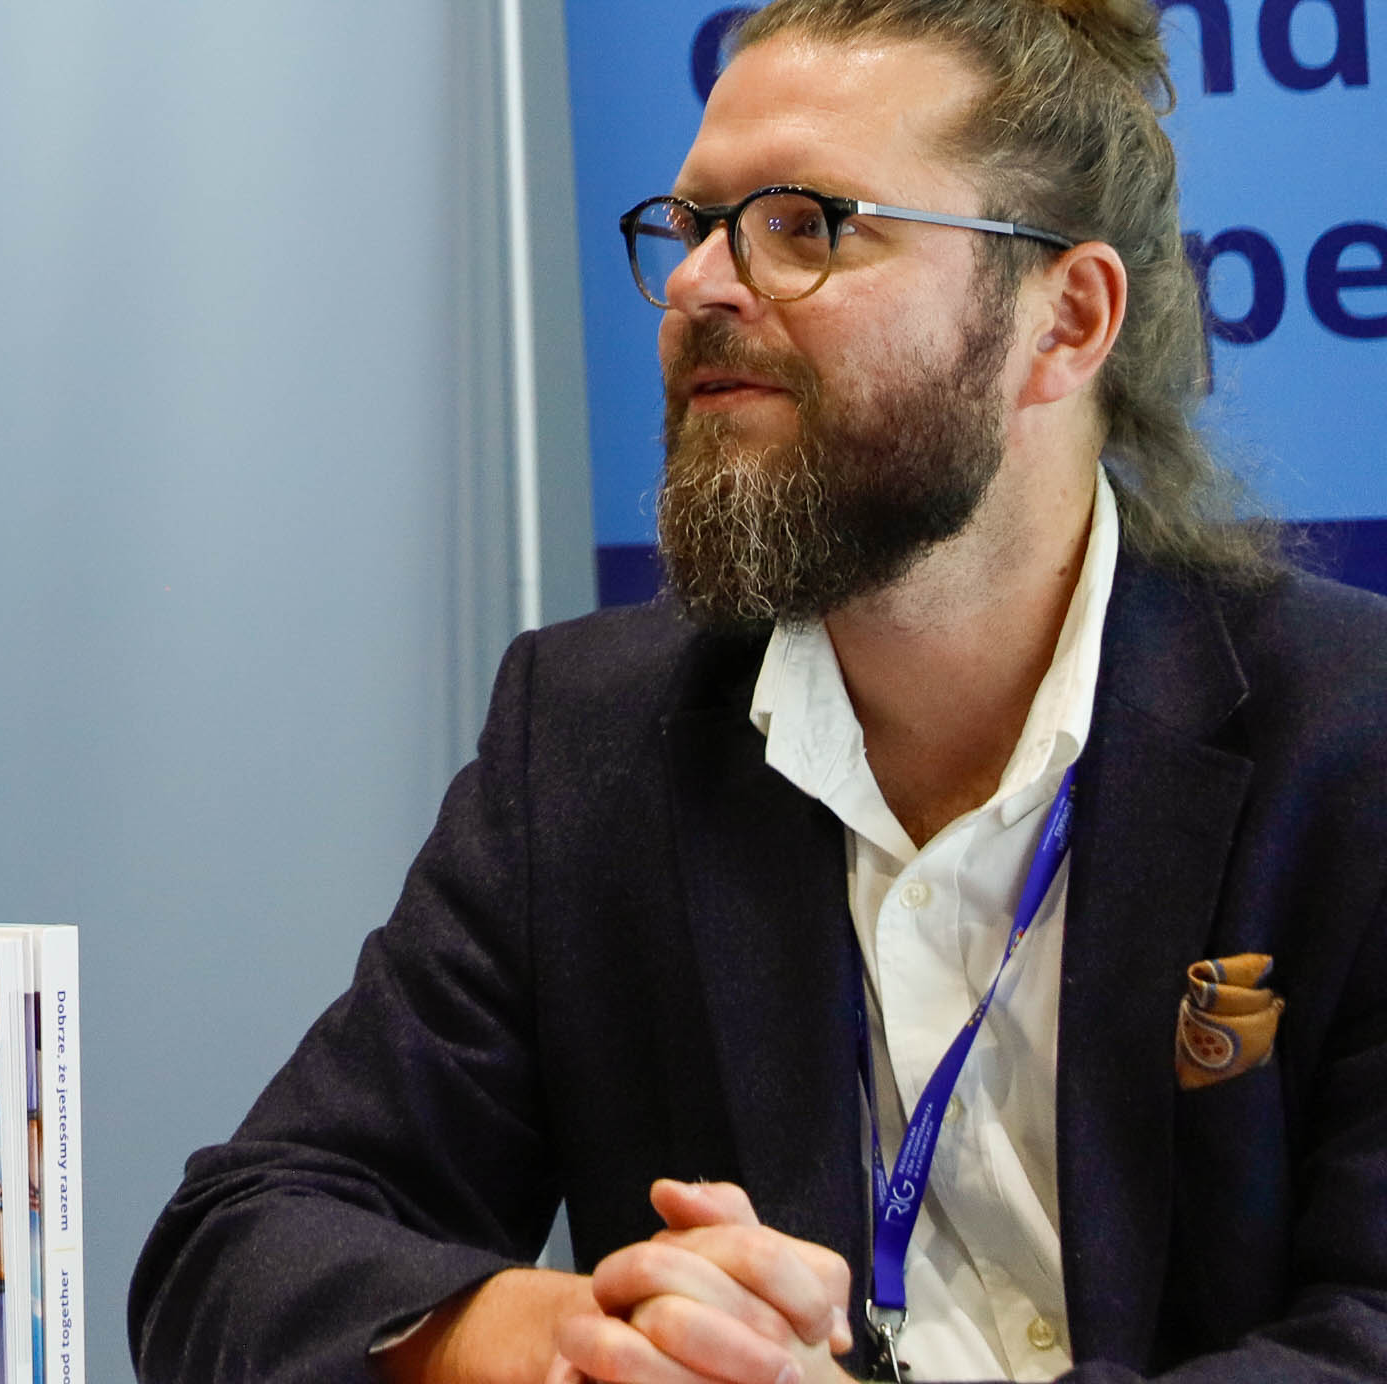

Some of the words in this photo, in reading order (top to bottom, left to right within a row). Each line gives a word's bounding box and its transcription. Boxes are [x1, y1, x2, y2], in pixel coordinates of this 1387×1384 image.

[1179, 221, 1387, 396] pe
[57, 991, 67, 1058] Dobrze,
[57, 1063, 67, 1083] że
[56, 1088, 69, 1170] jesteśmy
[59, 1175, 68, 1232] razem
[59, 1270, 72, 1347] together
[60, 1354, 71, 1384] ood
